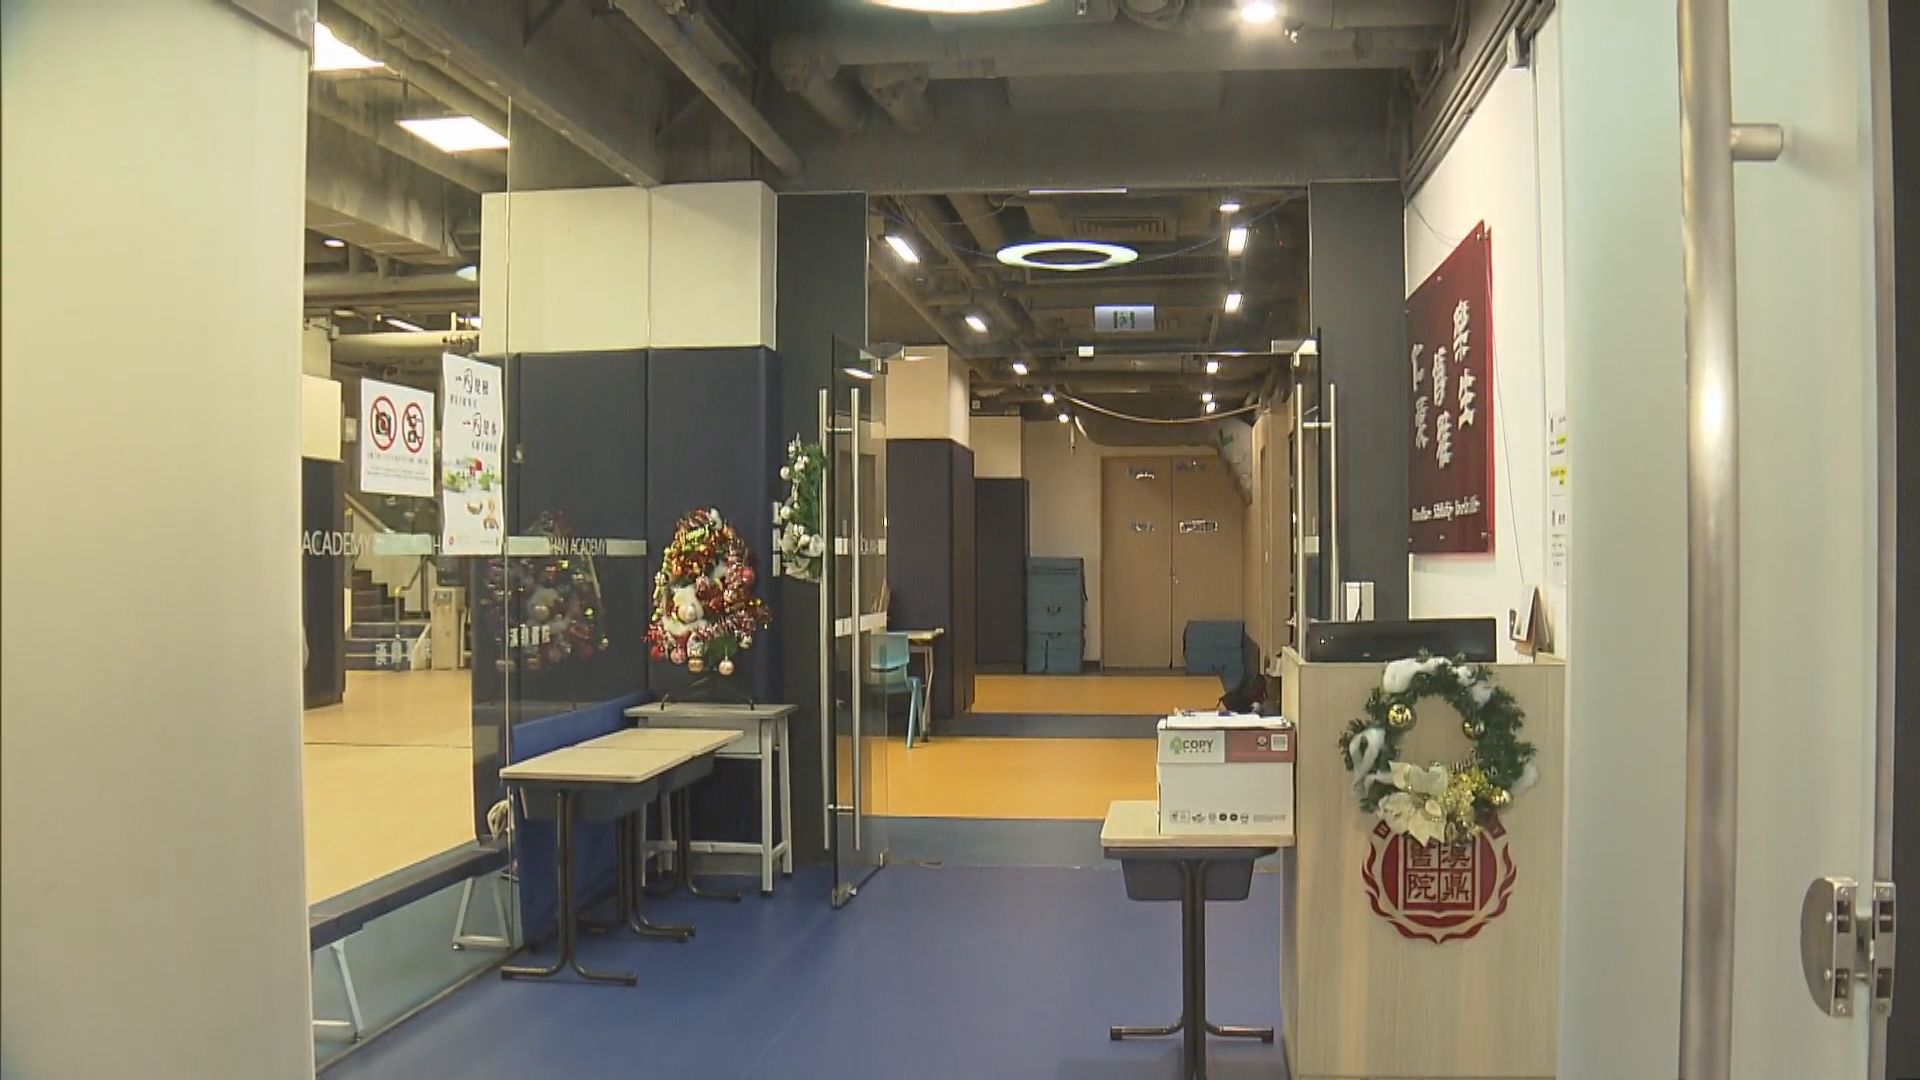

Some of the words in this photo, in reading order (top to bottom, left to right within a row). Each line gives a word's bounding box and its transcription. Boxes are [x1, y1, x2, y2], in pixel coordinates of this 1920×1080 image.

[303, 530, 373, 556] ACADEMY
[570, 537, 607, 556] ACADEMY
[1182, 739, 1214, 750] COPY
